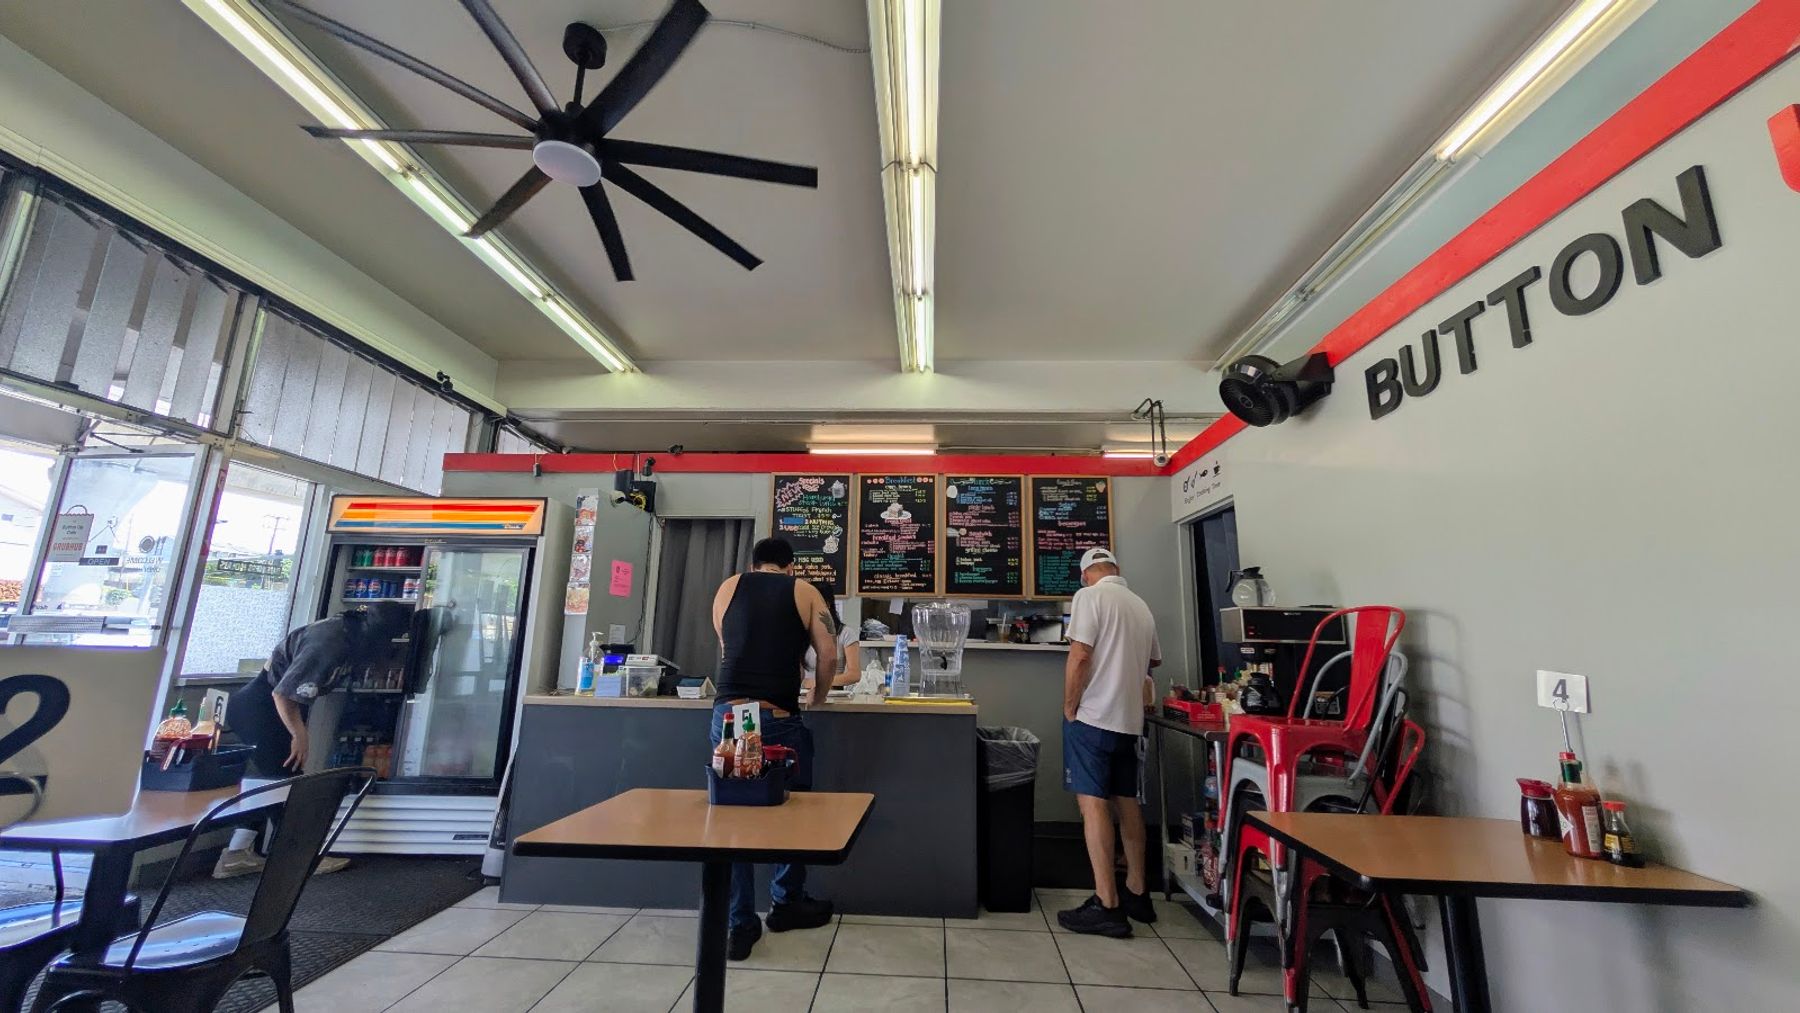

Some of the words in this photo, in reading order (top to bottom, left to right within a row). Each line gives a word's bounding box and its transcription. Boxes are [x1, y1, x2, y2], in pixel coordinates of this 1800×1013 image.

[1364, 165, 1723, 420] BUTTON
[53, 542, 84, 551] GRUBHUB
[1552, 679, 1569, 703] 4
[214, 695, 224, 718] 6
[0, 674, 71, 796] 2
